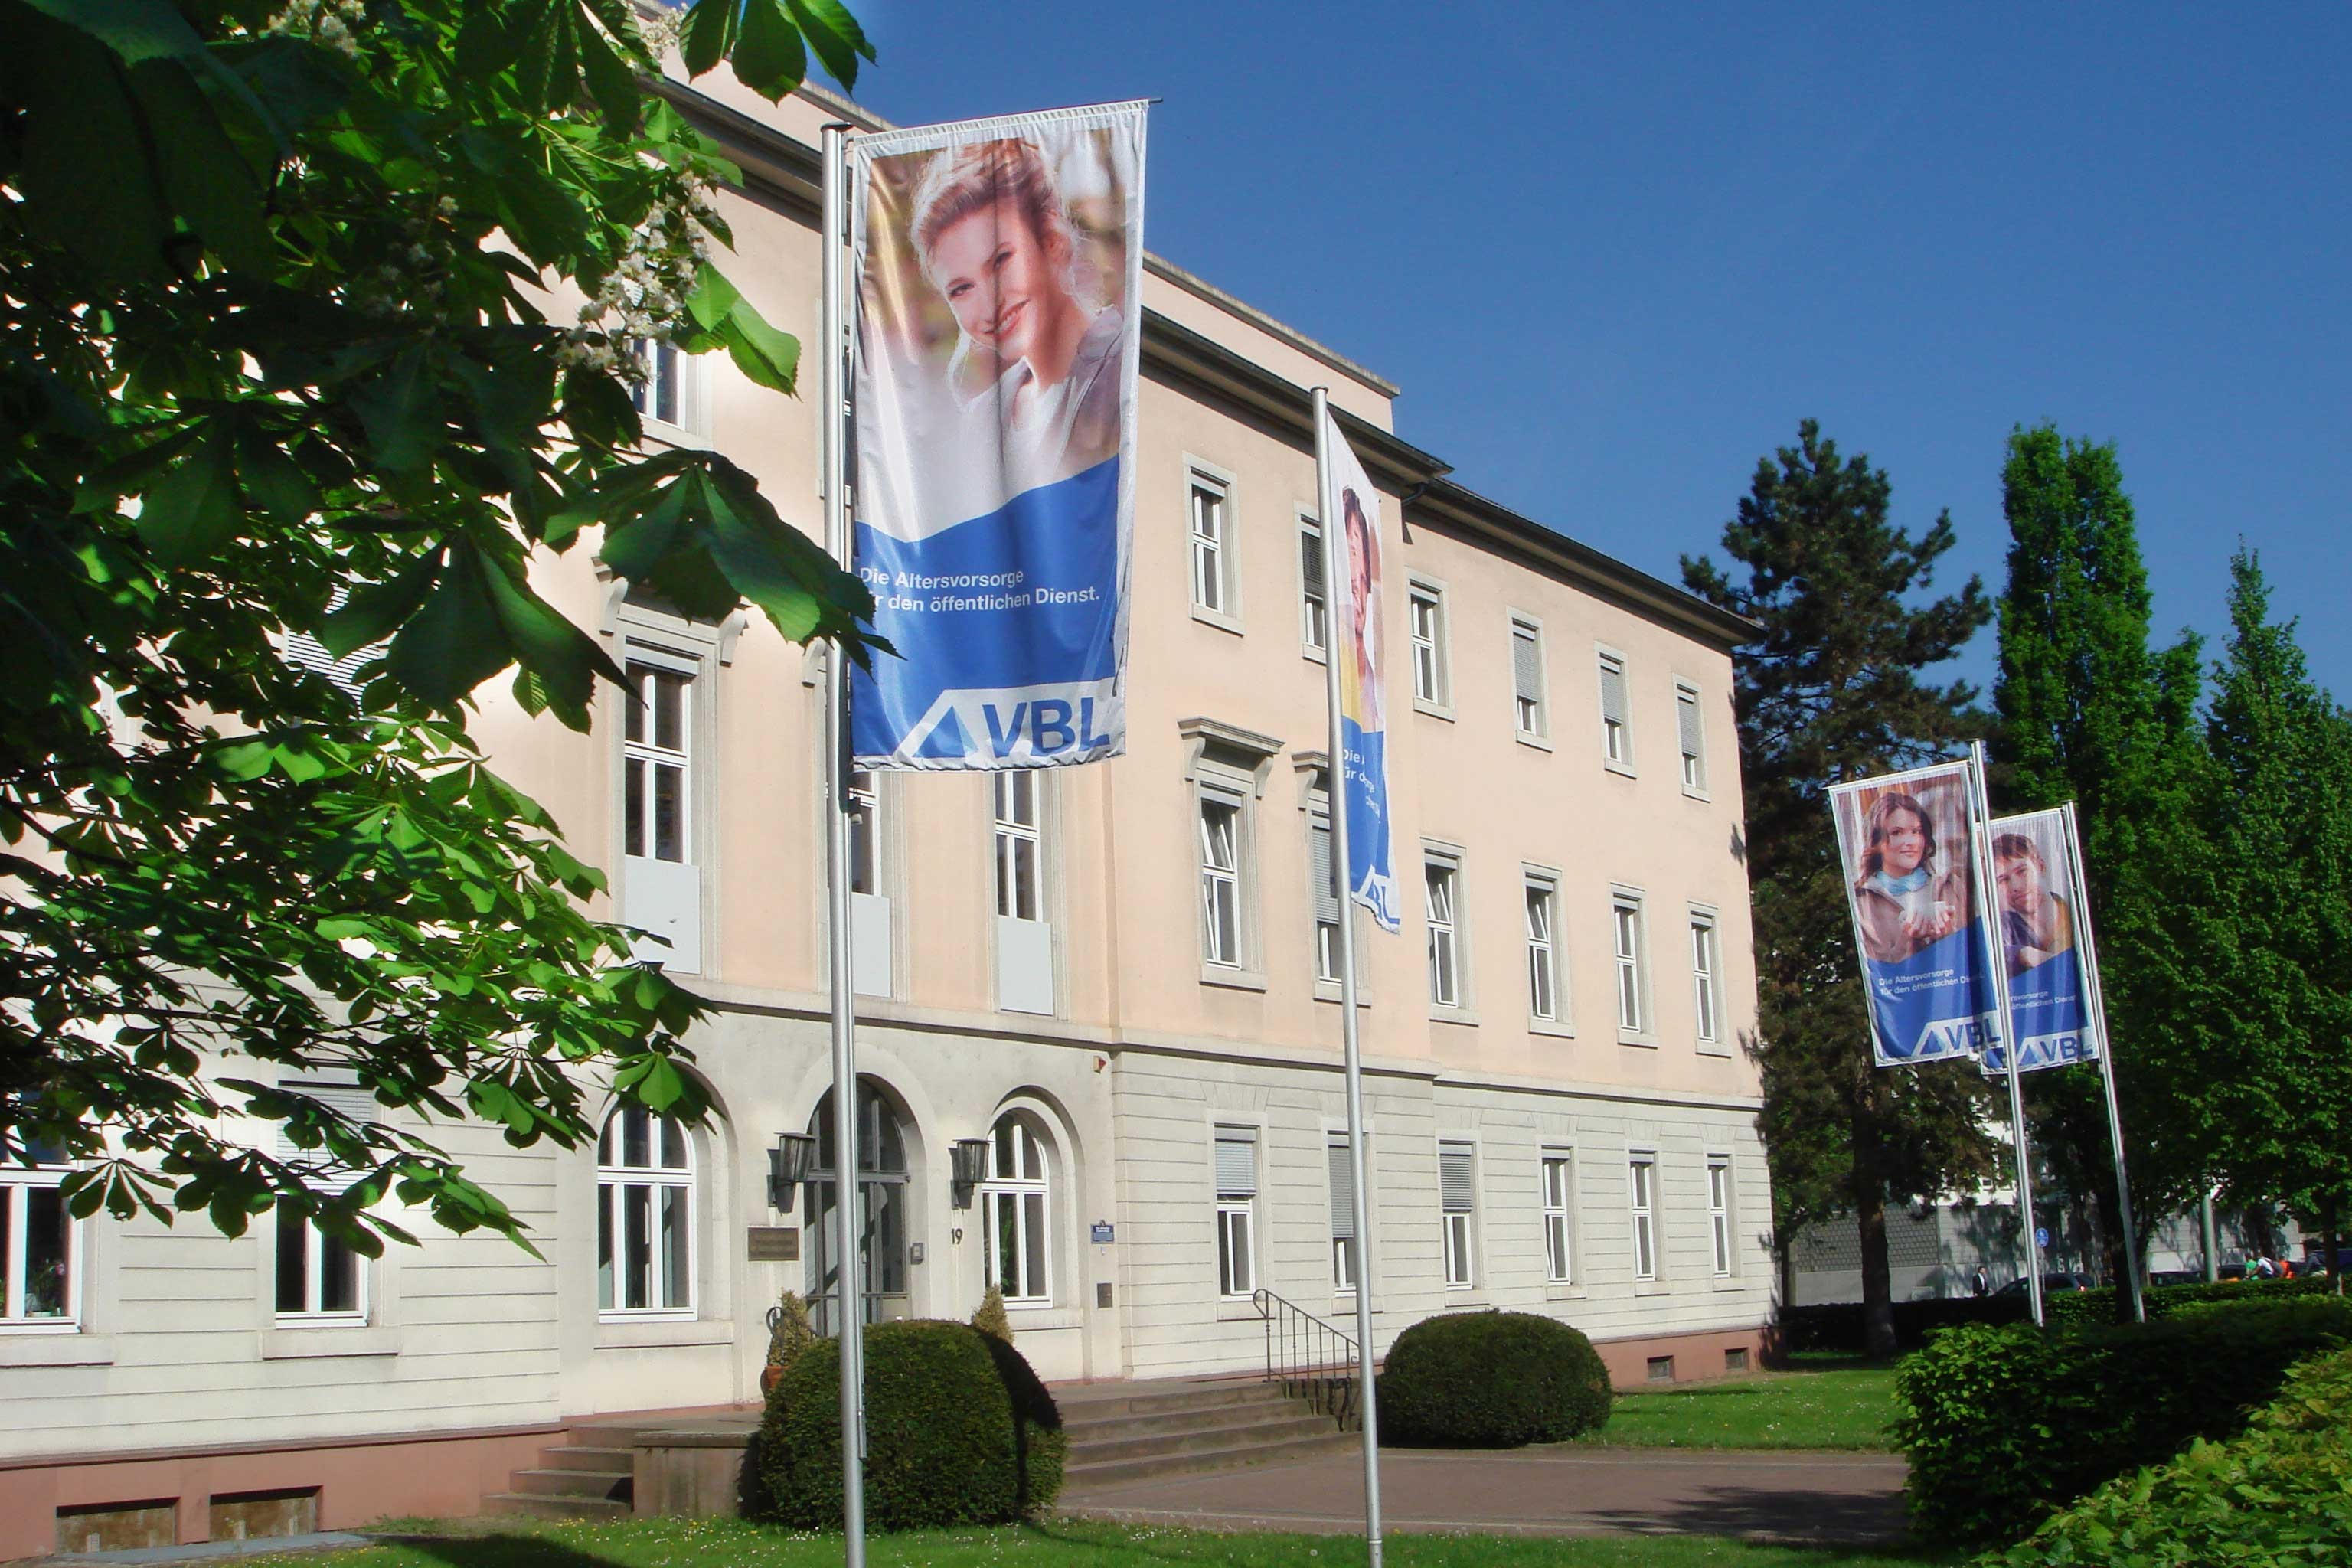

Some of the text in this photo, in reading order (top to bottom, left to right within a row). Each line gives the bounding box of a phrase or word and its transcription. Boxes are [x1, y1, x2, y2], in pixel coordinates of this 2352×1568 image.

[860, 567, 1024, 589] Die Altersvorsorge
[888, 594, 924, 612] den
[929, 592, 1031, 613] öffentlichen
[1035, 586, 1099, 604] Dienst.
[982, 697, 1111, 758] VBL
[1894, 986, 1910, 995] den
[1912, 978, 1958, 992] öffentlichen
[1895, 969, 1954, 984] Altersvorsorge
[1945, 1018, 2001, 1050] VBL
[2040, 1036, 2093, 1061] VBL
[951, 1228, 963, 1245] 19
